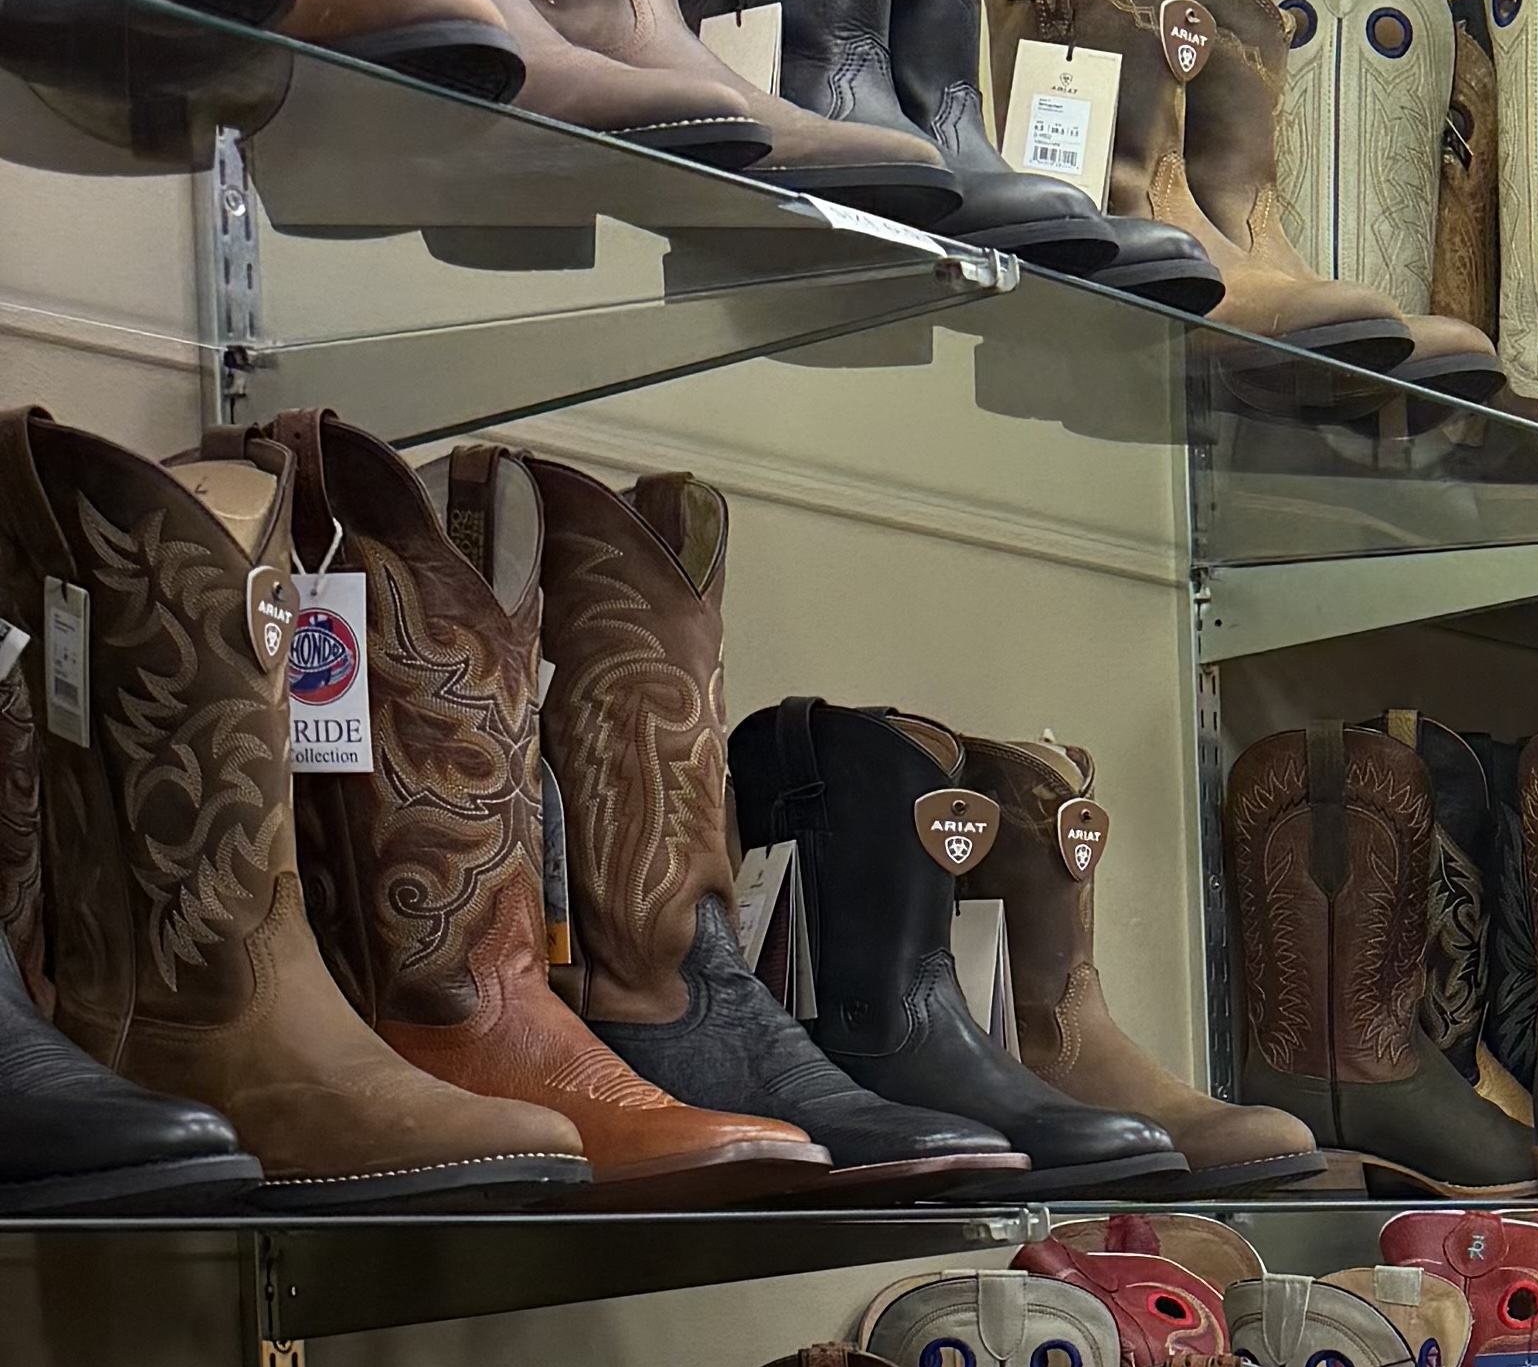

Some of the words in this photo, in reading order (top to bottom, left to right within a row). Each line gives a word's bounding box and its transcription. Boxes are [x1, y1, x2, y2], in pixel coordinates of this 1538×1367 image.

[1169, 25, 1208, 47] ARIAT
[257, 599, 293, 625] ARIAT
[291, 632, 344, 666] HONDO
[293, 718, 363, 744] RIDE
[930, 819, 988, 835] ARIAT
[1067, 828, 1102, 843] ARIAT
